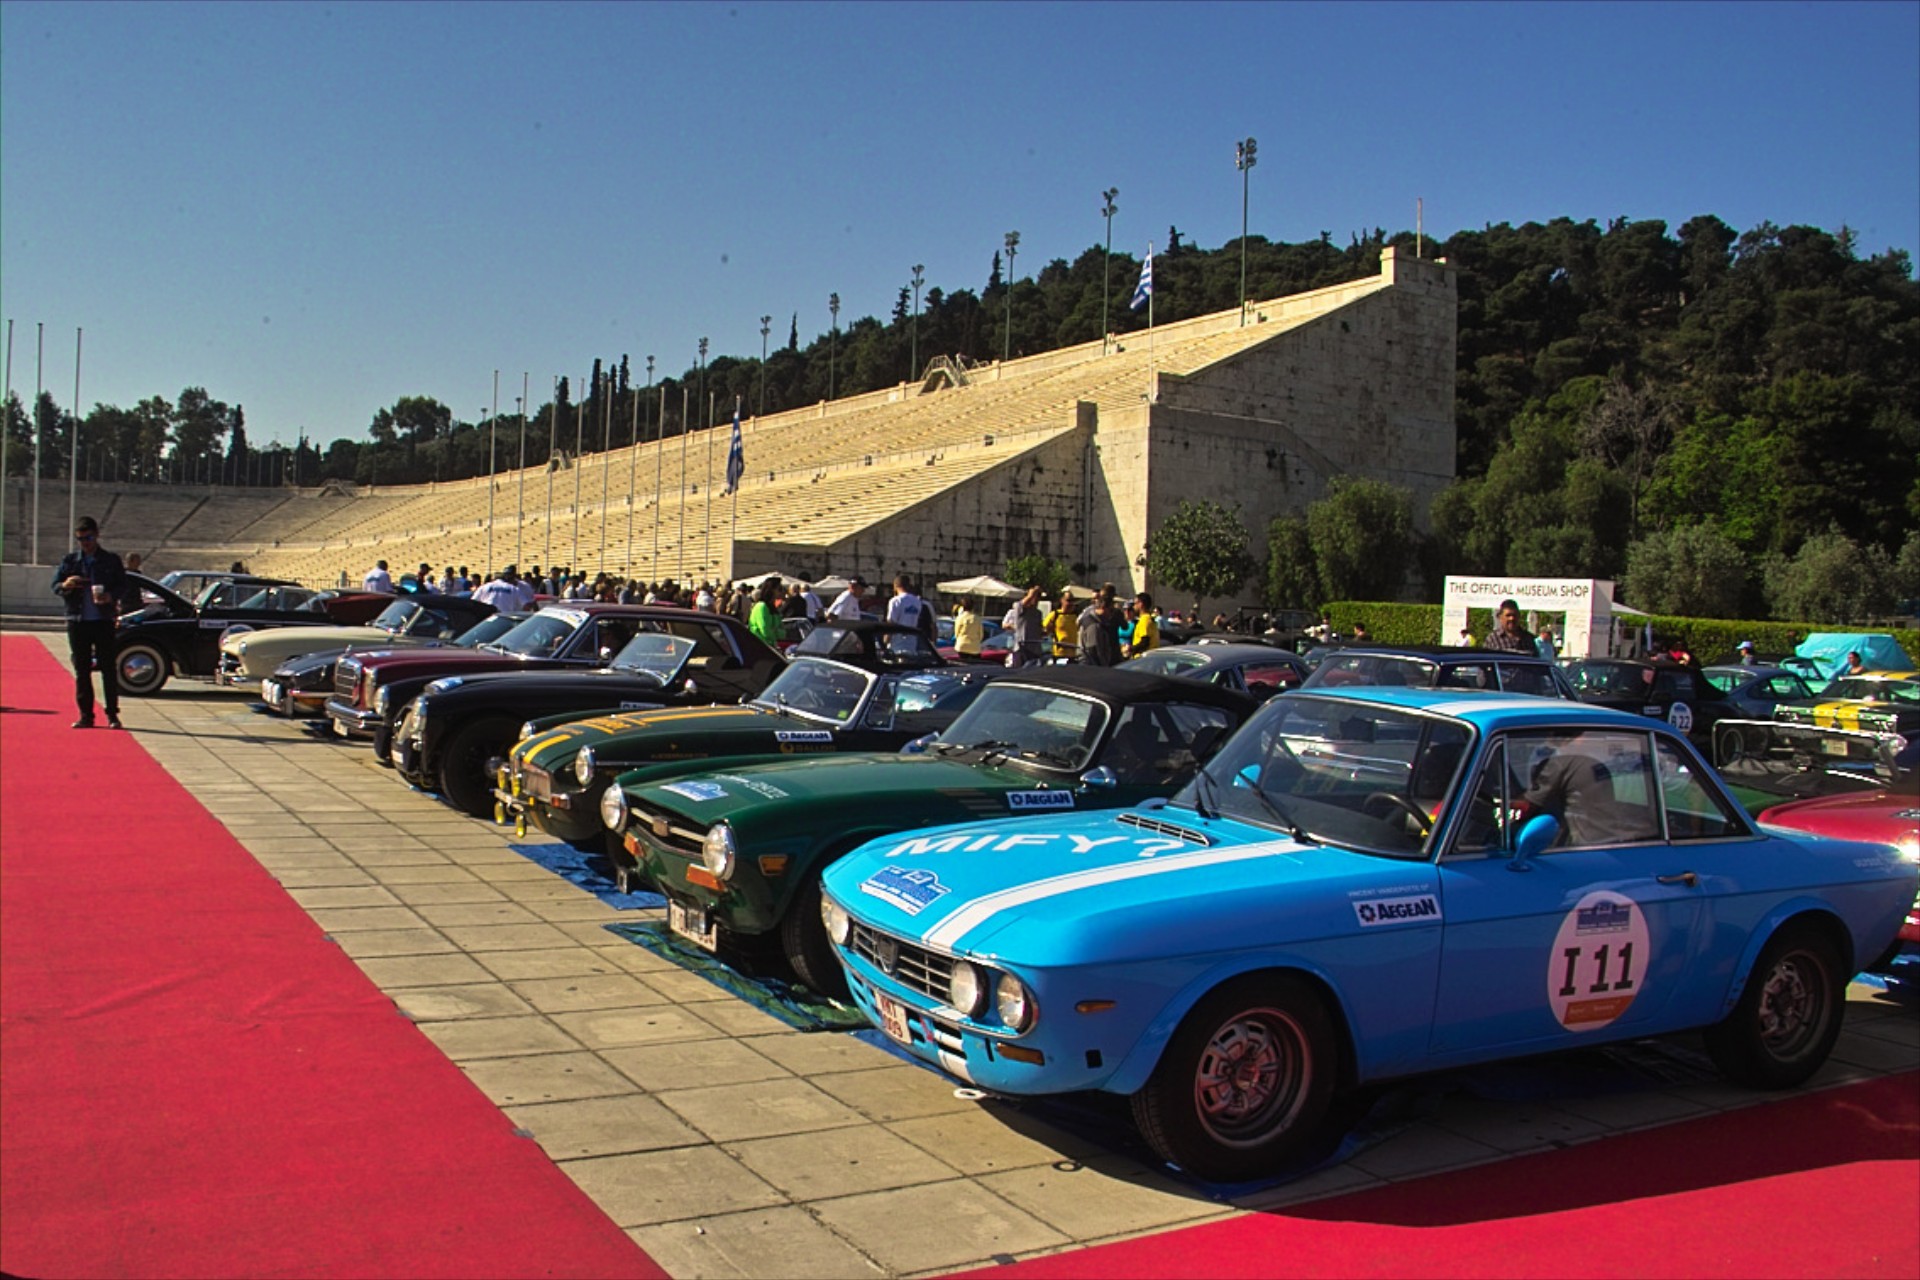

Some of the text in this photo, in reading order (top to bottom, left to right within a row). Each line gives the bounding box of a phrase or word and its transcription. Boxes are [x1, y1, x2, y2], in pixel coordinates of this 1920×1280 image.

[1449, 582, 1589, 598] THE OFFICIAL MUSEUM SHOP
[1679, 715, 1690, 728] 22
[1024, 792, 1071, 805] AEGEAN
[885, 834, 1185, 857] MIFY?
[1377, 898, 1437, 920] AEGEAN
[1559, 942, 1633, 996] I 11
